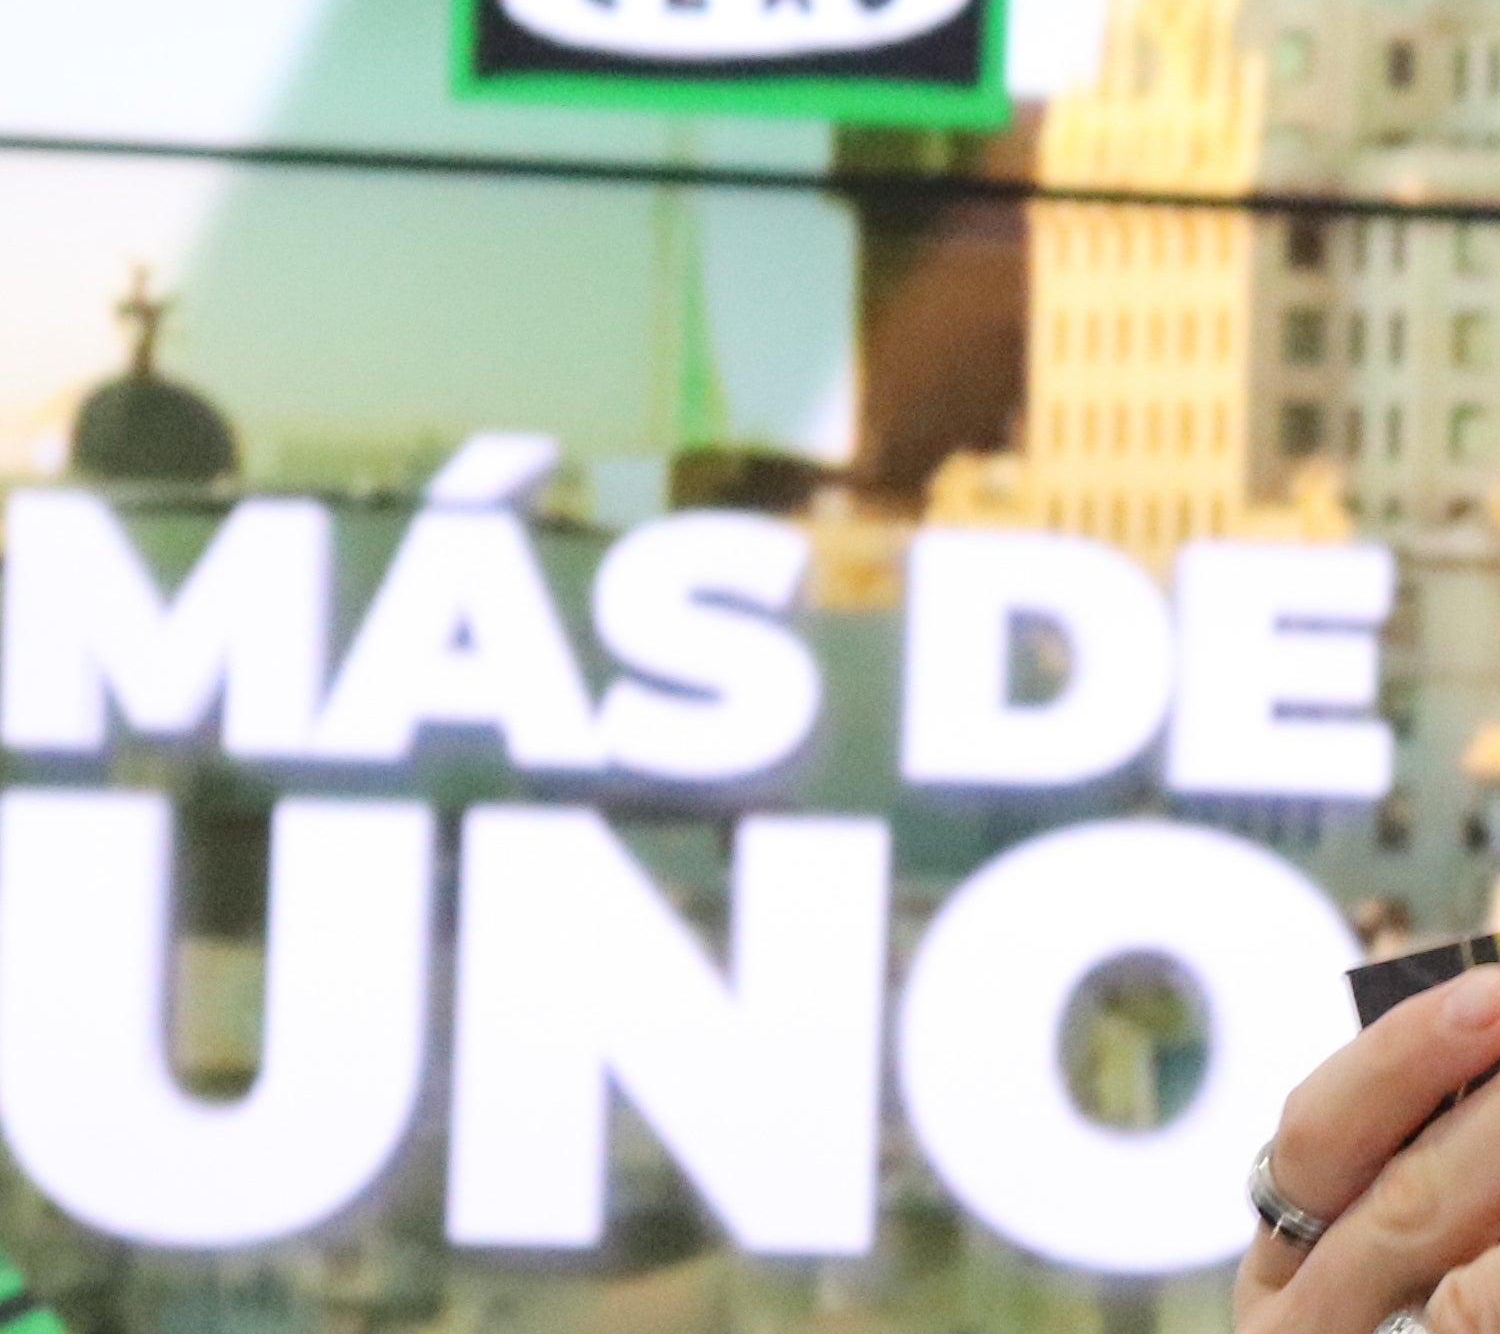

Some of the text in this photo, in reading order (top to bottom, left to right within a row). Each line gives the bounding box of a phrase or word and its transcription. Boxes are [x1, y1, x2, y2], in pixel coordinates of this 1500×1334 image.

[2, 432, 1396, 798] MÁS DE
[0, 787, 1372, 1276] UNO
